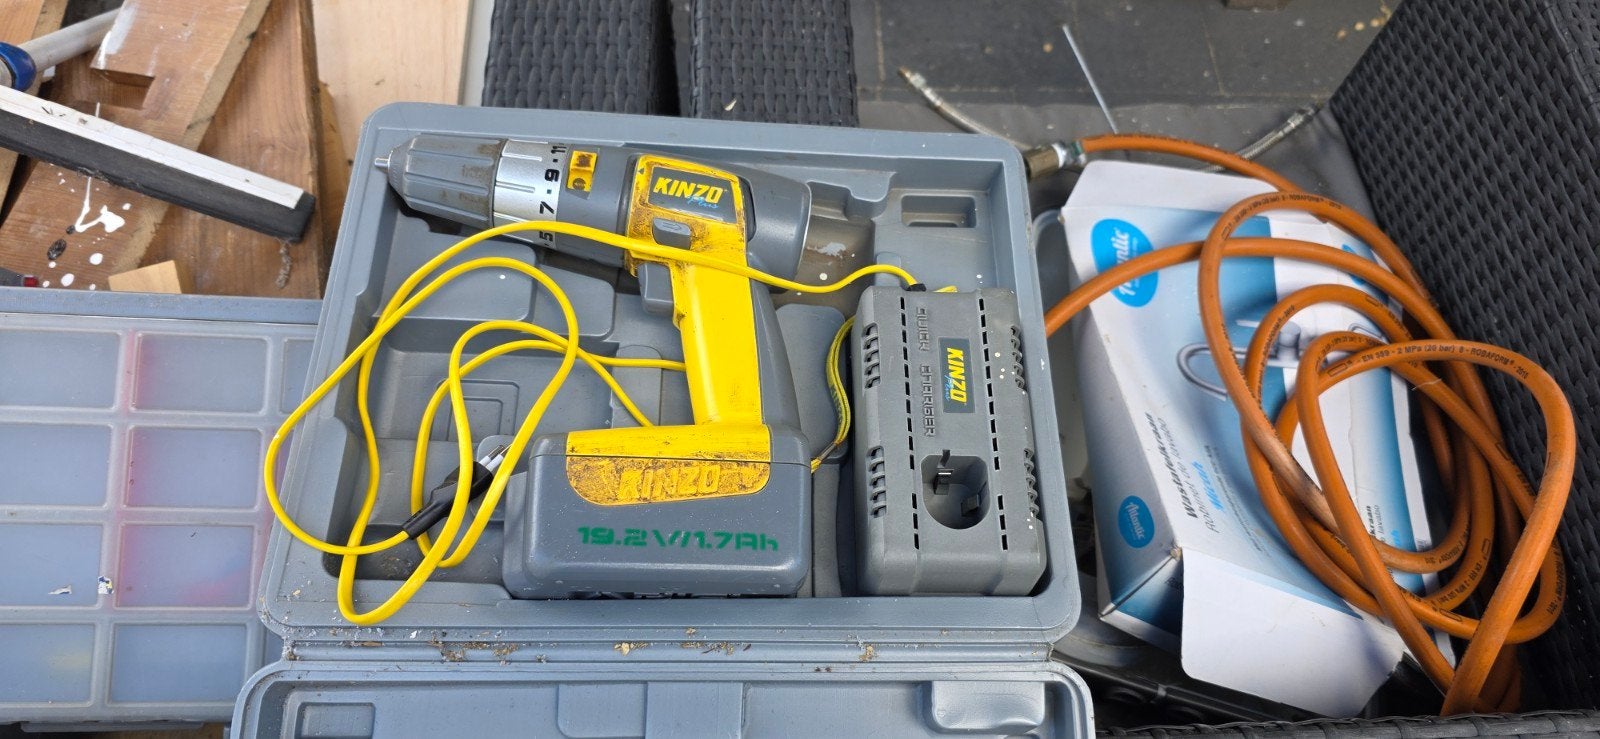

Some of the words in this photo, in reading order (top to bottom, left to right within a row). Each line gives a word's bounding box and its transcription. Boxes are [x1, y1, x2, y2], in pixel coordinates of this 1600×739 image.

[544, 168, 560, 182] 9
[653, 176, 724, 204] KINZO
[539, 200, 555, 214] 7
[1111, 227, 1136, 296] Antic
[946, 347, 968, 403] KINZO
[920, 364, 936, 438] CHARGER
[618, 464, 721, 500] KINZO
[1144, 412, 1198, 519] Wastafelkraan
[1125, 501, 1146, 540] Atlantic
